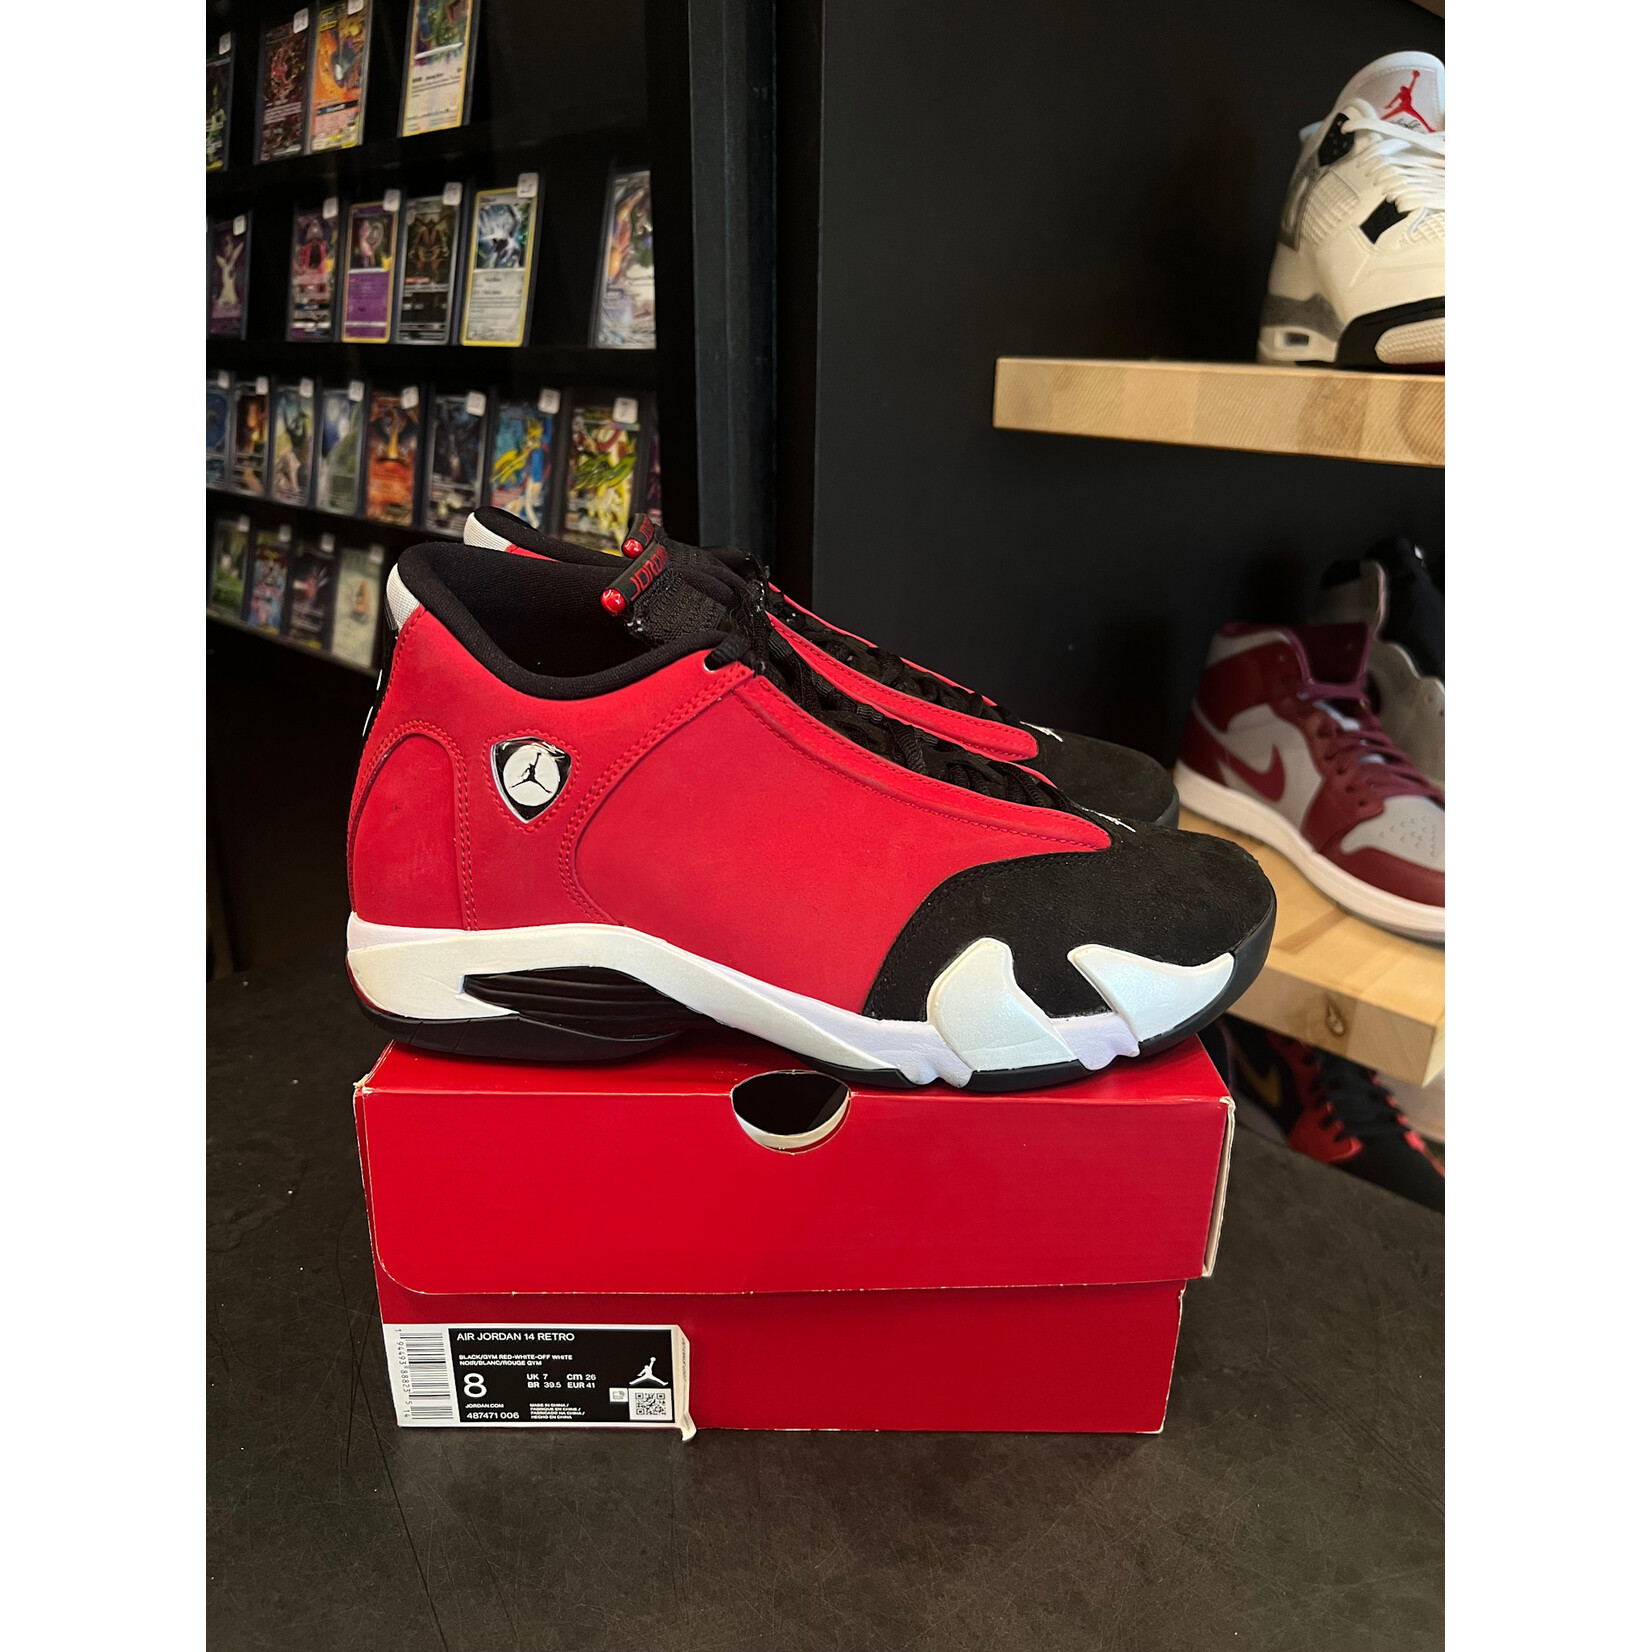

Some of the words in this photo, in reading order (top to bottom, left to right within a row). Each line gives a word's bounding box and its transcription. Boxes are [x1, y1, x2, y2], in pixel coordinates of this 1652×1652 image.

[456, 1332, 474, 1341] AIR
[477, 1332, 522, 1341] JORDAN
[524, 1332, 534, 1341] 14
[538, 1332, 575, 1341] RETRO
[463, 1372, 487, 1398] 8
[466, 1412, 498, 1420] 487471
